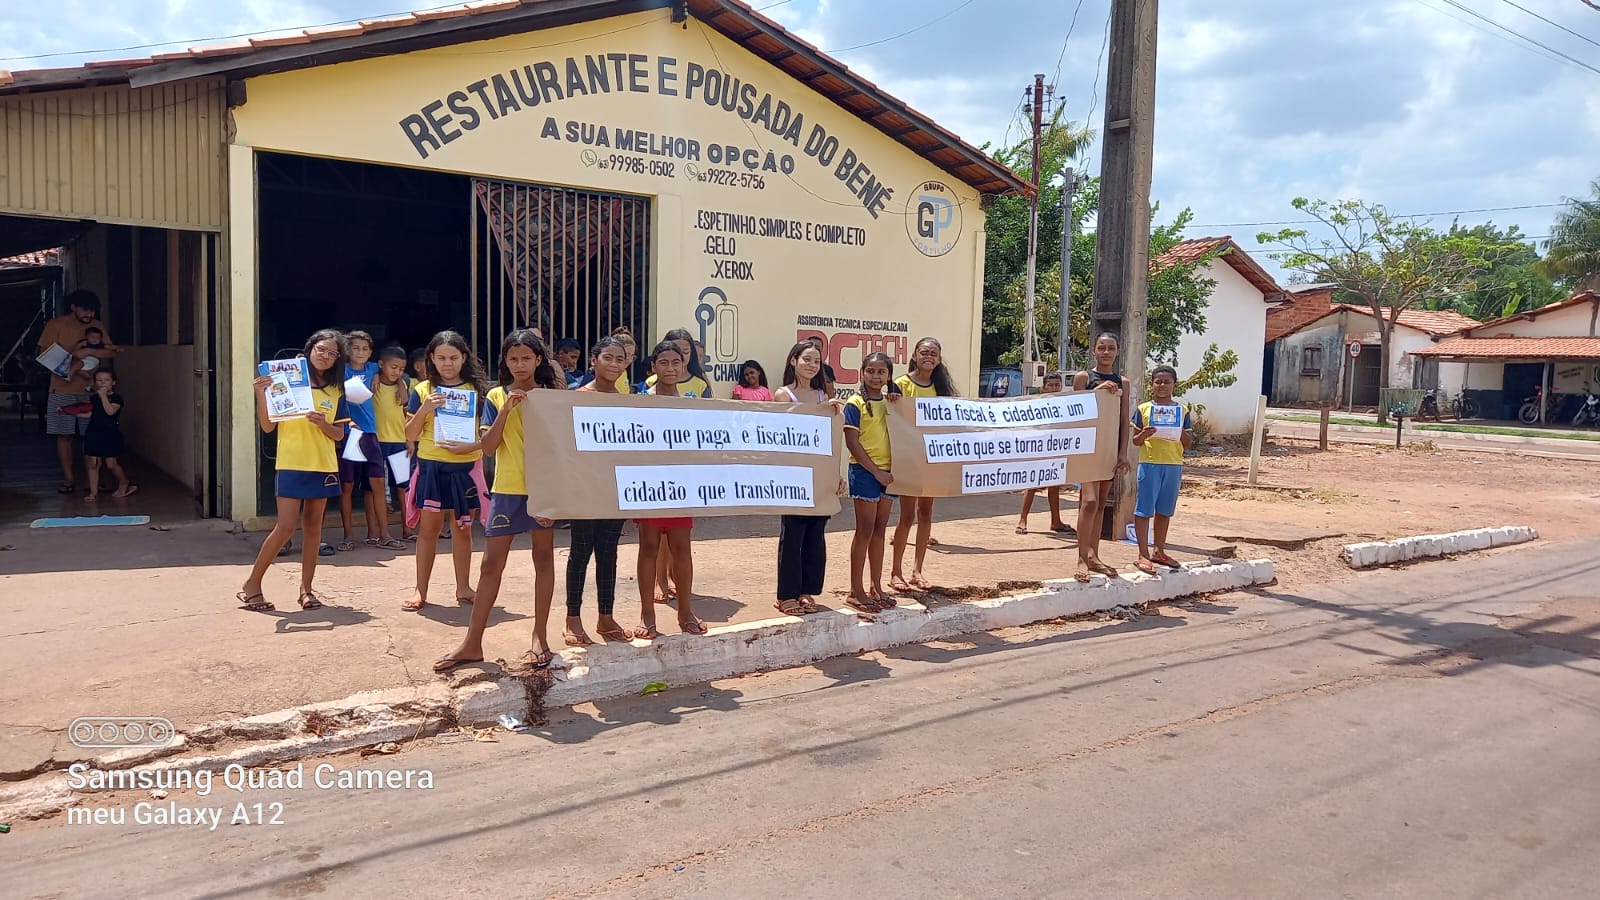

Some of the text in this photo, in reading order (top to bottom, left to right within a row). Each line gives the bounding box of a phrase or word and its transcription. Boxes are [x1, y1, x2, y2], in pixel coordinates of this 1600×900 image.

[399, 53, 895, 220] RESTAURANTE E POUSADA DO BENÉ
[540, 116, 795, 175] A SUA MELHOR OPÇÃO
[923, 183, 945, 193] GRUPO
[806, 223, 812, 242] E
[814, 224, 866, 246] COMPLETO
[862, 320, 908, 332] ESPECIALIZADA
[1351, 344, 1360, 353] 40
[714, 363, 745, 382] CHAV
[955, 403, 987, 422] fiscal
[988, 405, 997, 423] é
[1002, 402, 1063, 423] cidadania:
[1067, 402, 1084, 417] um
[581, 422, 820, 450] "Cidadão que paga e fiscaliza é
[928, 435, 1081, 459] direito que se torna dever e
[965, 468, 1027, 488] transforma
[1029, 470, 1036, 482] o
[624, 480, 811, 505] cidadão que transforma.
